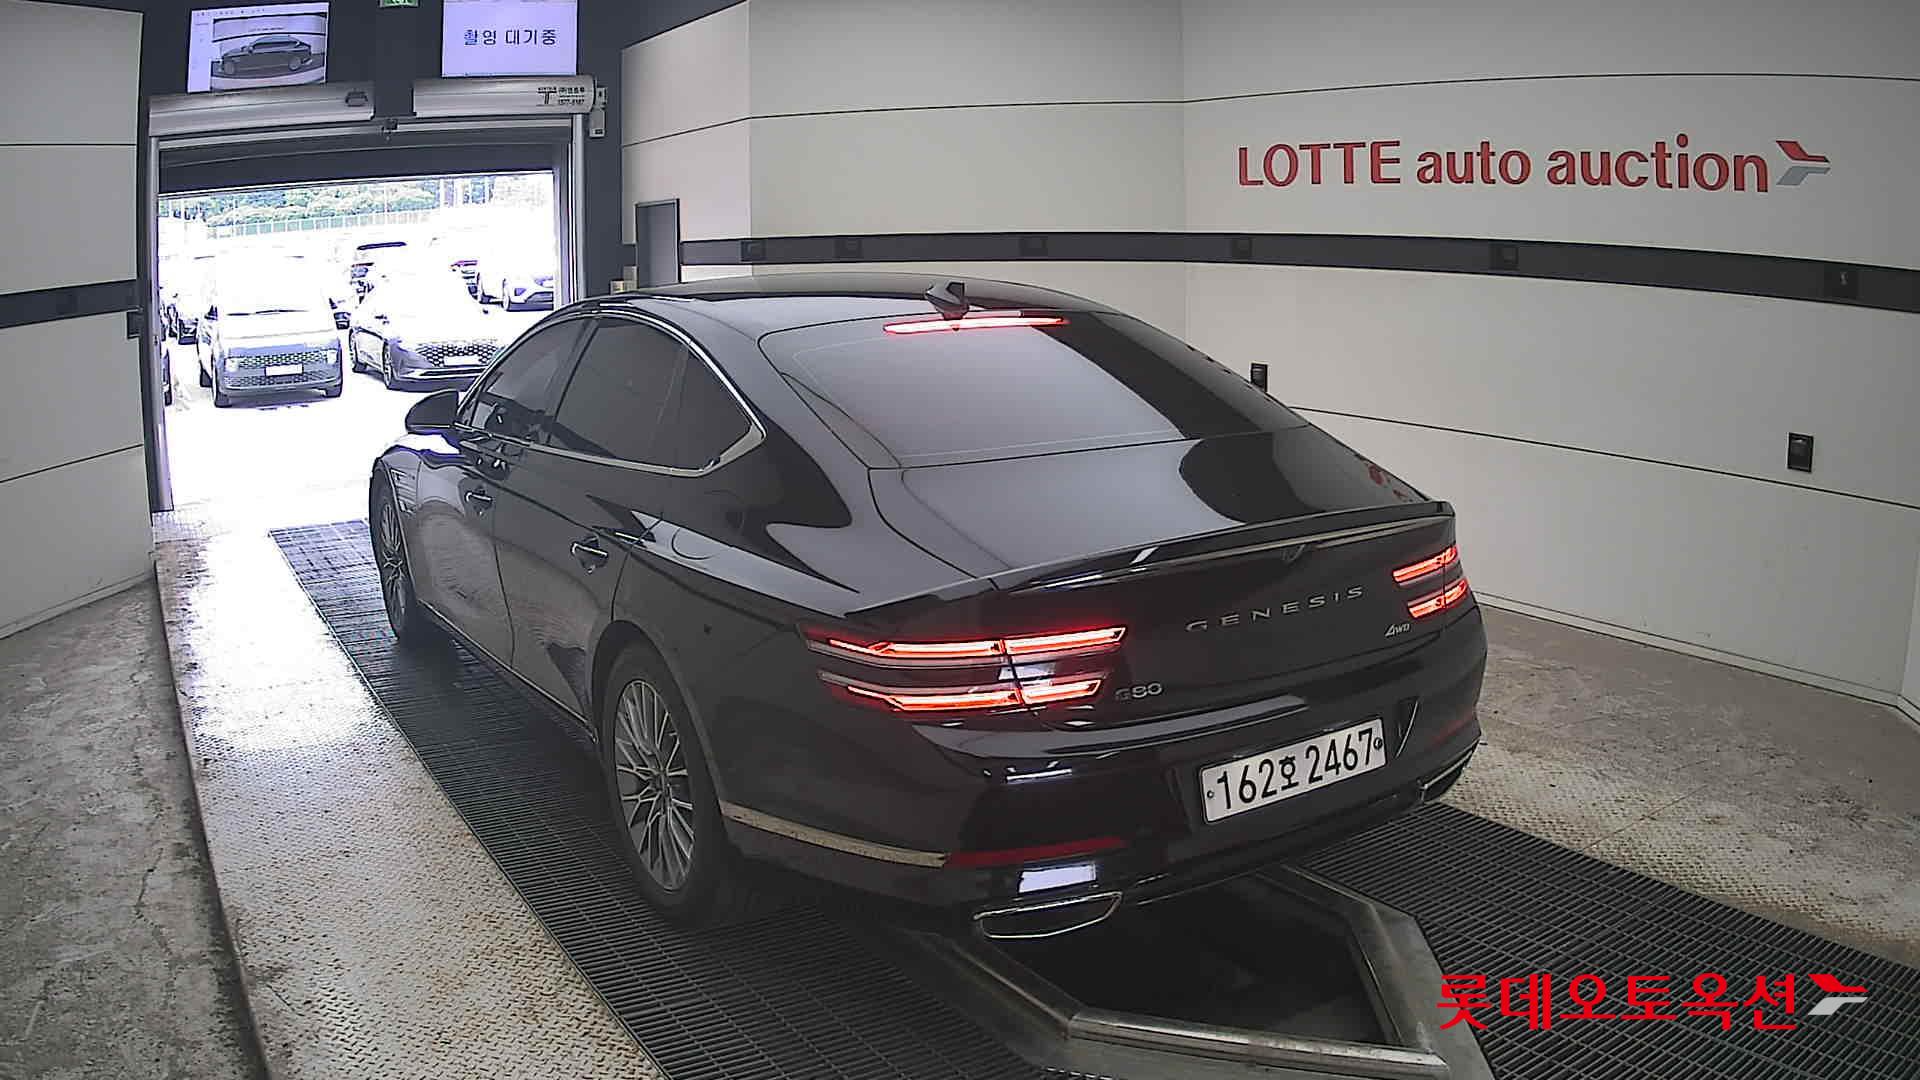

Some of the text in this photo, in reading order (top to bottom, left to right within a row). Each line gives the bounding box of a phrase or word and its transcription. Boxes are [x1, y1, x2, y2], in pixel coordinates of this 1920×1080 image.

[464, 29, 557, 46] 촬영 대기중
[1239, 133, 1769, 193] LOTTE auto auction
[1185, 586, 1363, 632] GENESIS
